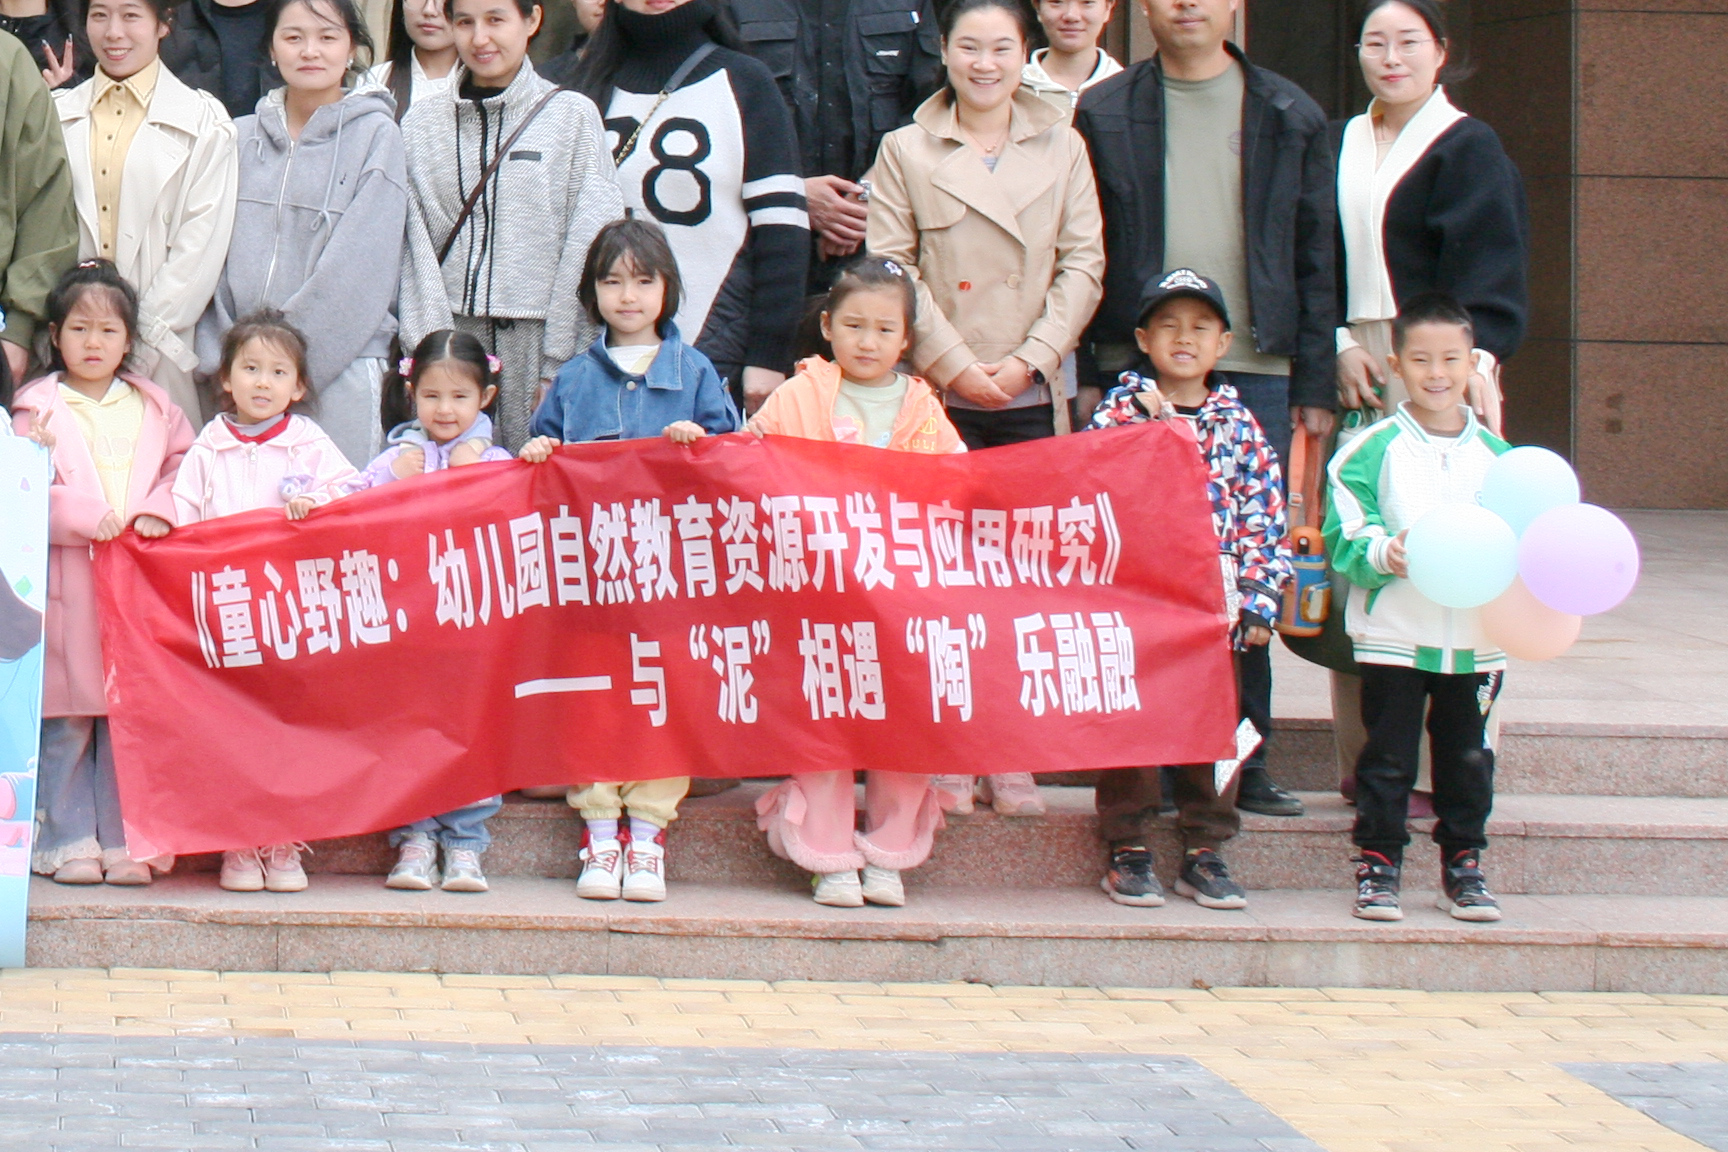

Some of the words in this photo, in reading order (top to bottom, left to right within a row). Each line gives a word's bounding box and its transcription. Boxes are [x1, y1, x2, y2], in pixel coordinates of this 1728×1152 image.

[191, 491, 1123, 669] 《童心野趣：幼儿园自然教育资源开发与应用研究》
